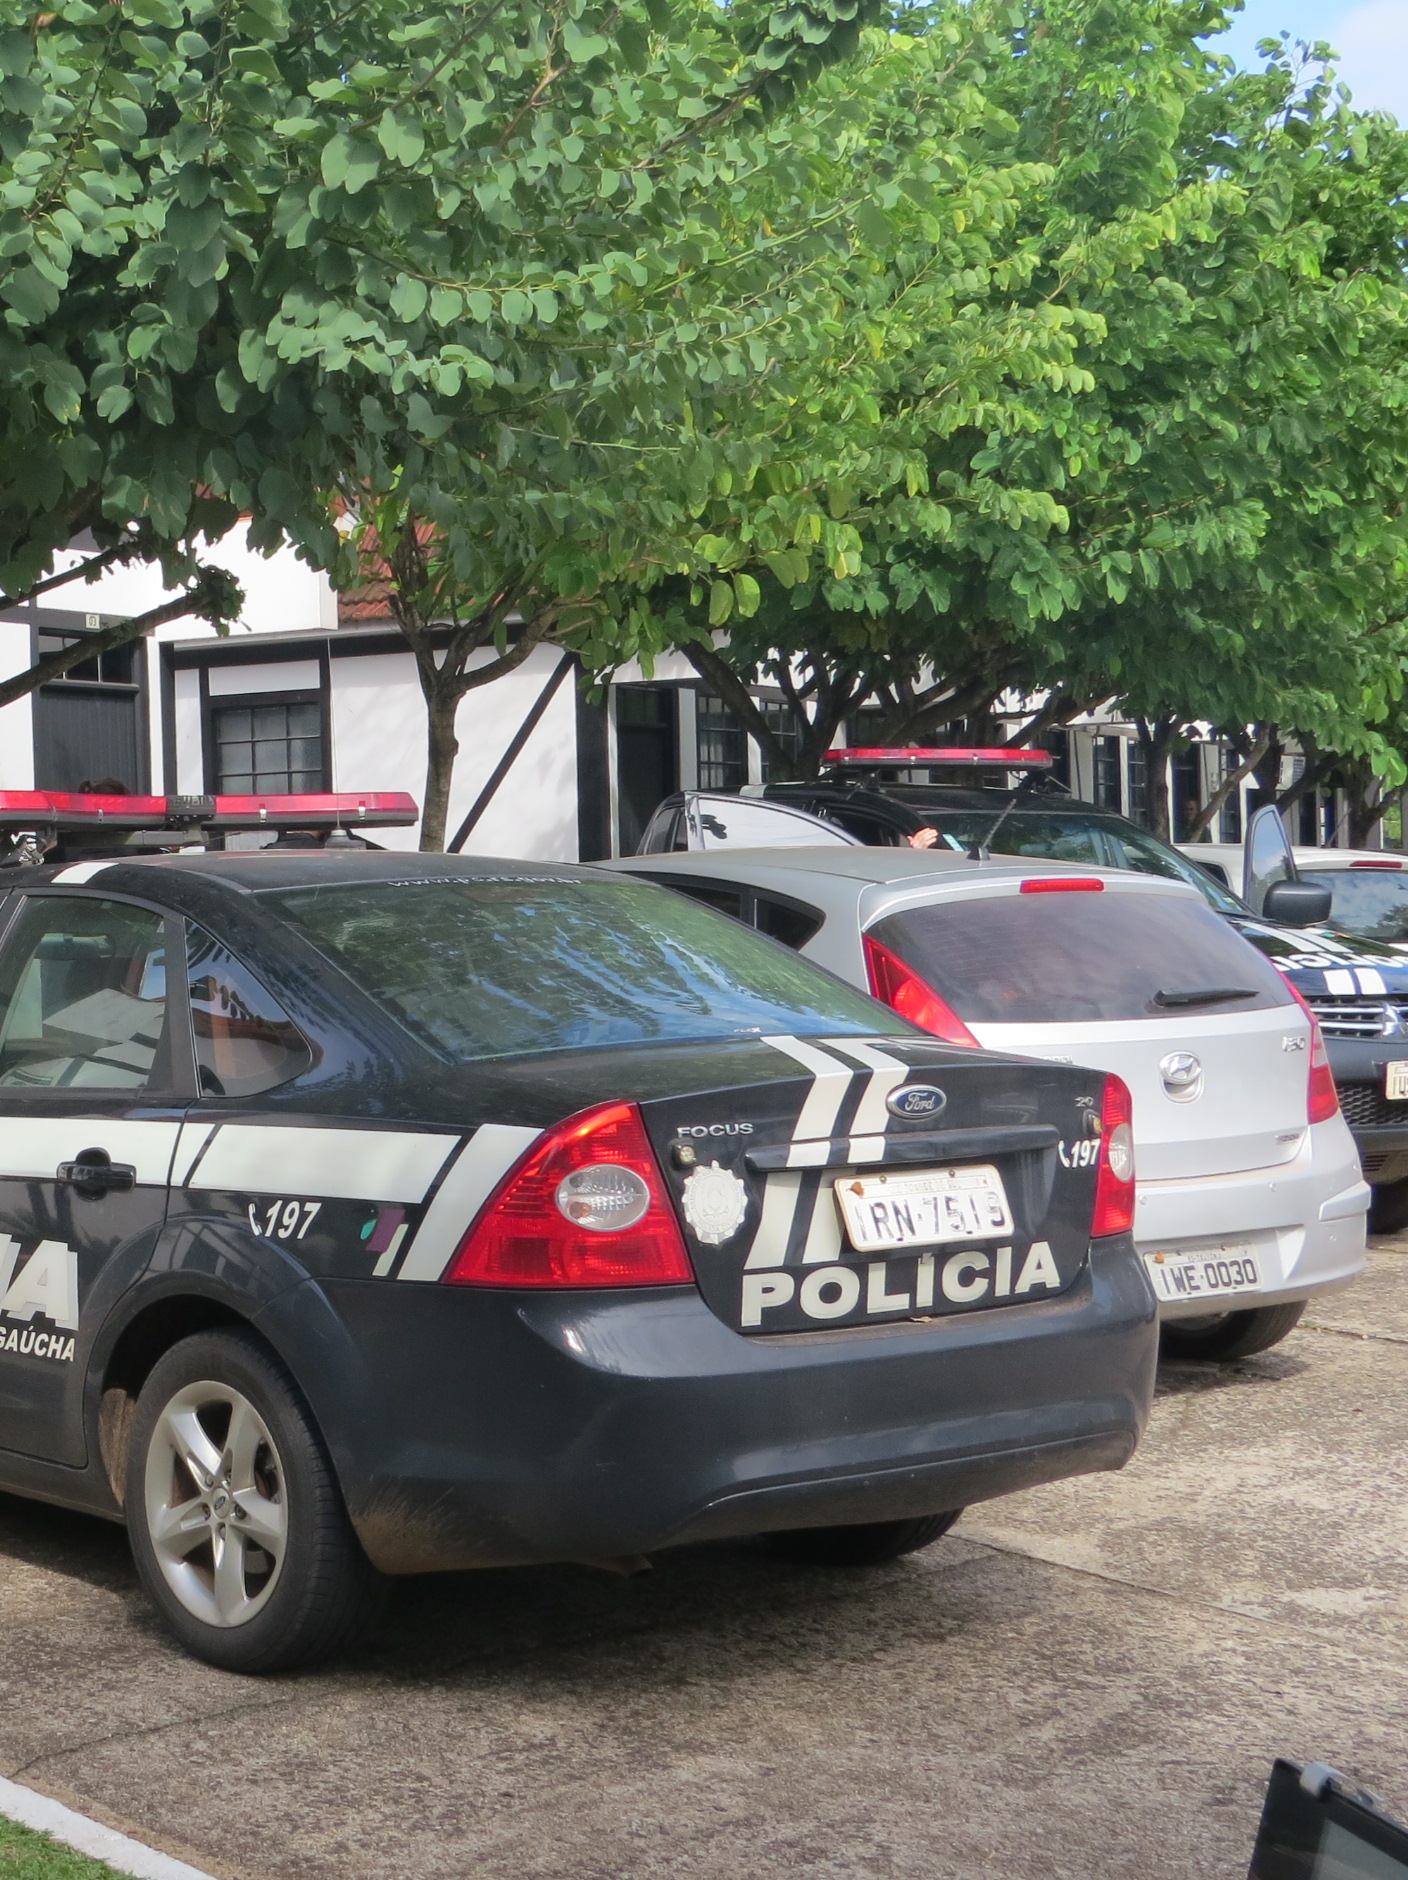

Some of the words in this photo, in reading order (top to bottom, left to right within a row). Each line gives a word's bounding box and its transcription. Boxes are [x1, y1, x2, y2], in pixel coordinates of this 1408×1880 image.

[904, 1092, 935, 1111] Ford
[677, 1122, 754, 1139] FOCUS
[1071, 1138, 1101, 1168] 197
[264, 1200, 322, 1239] 197
